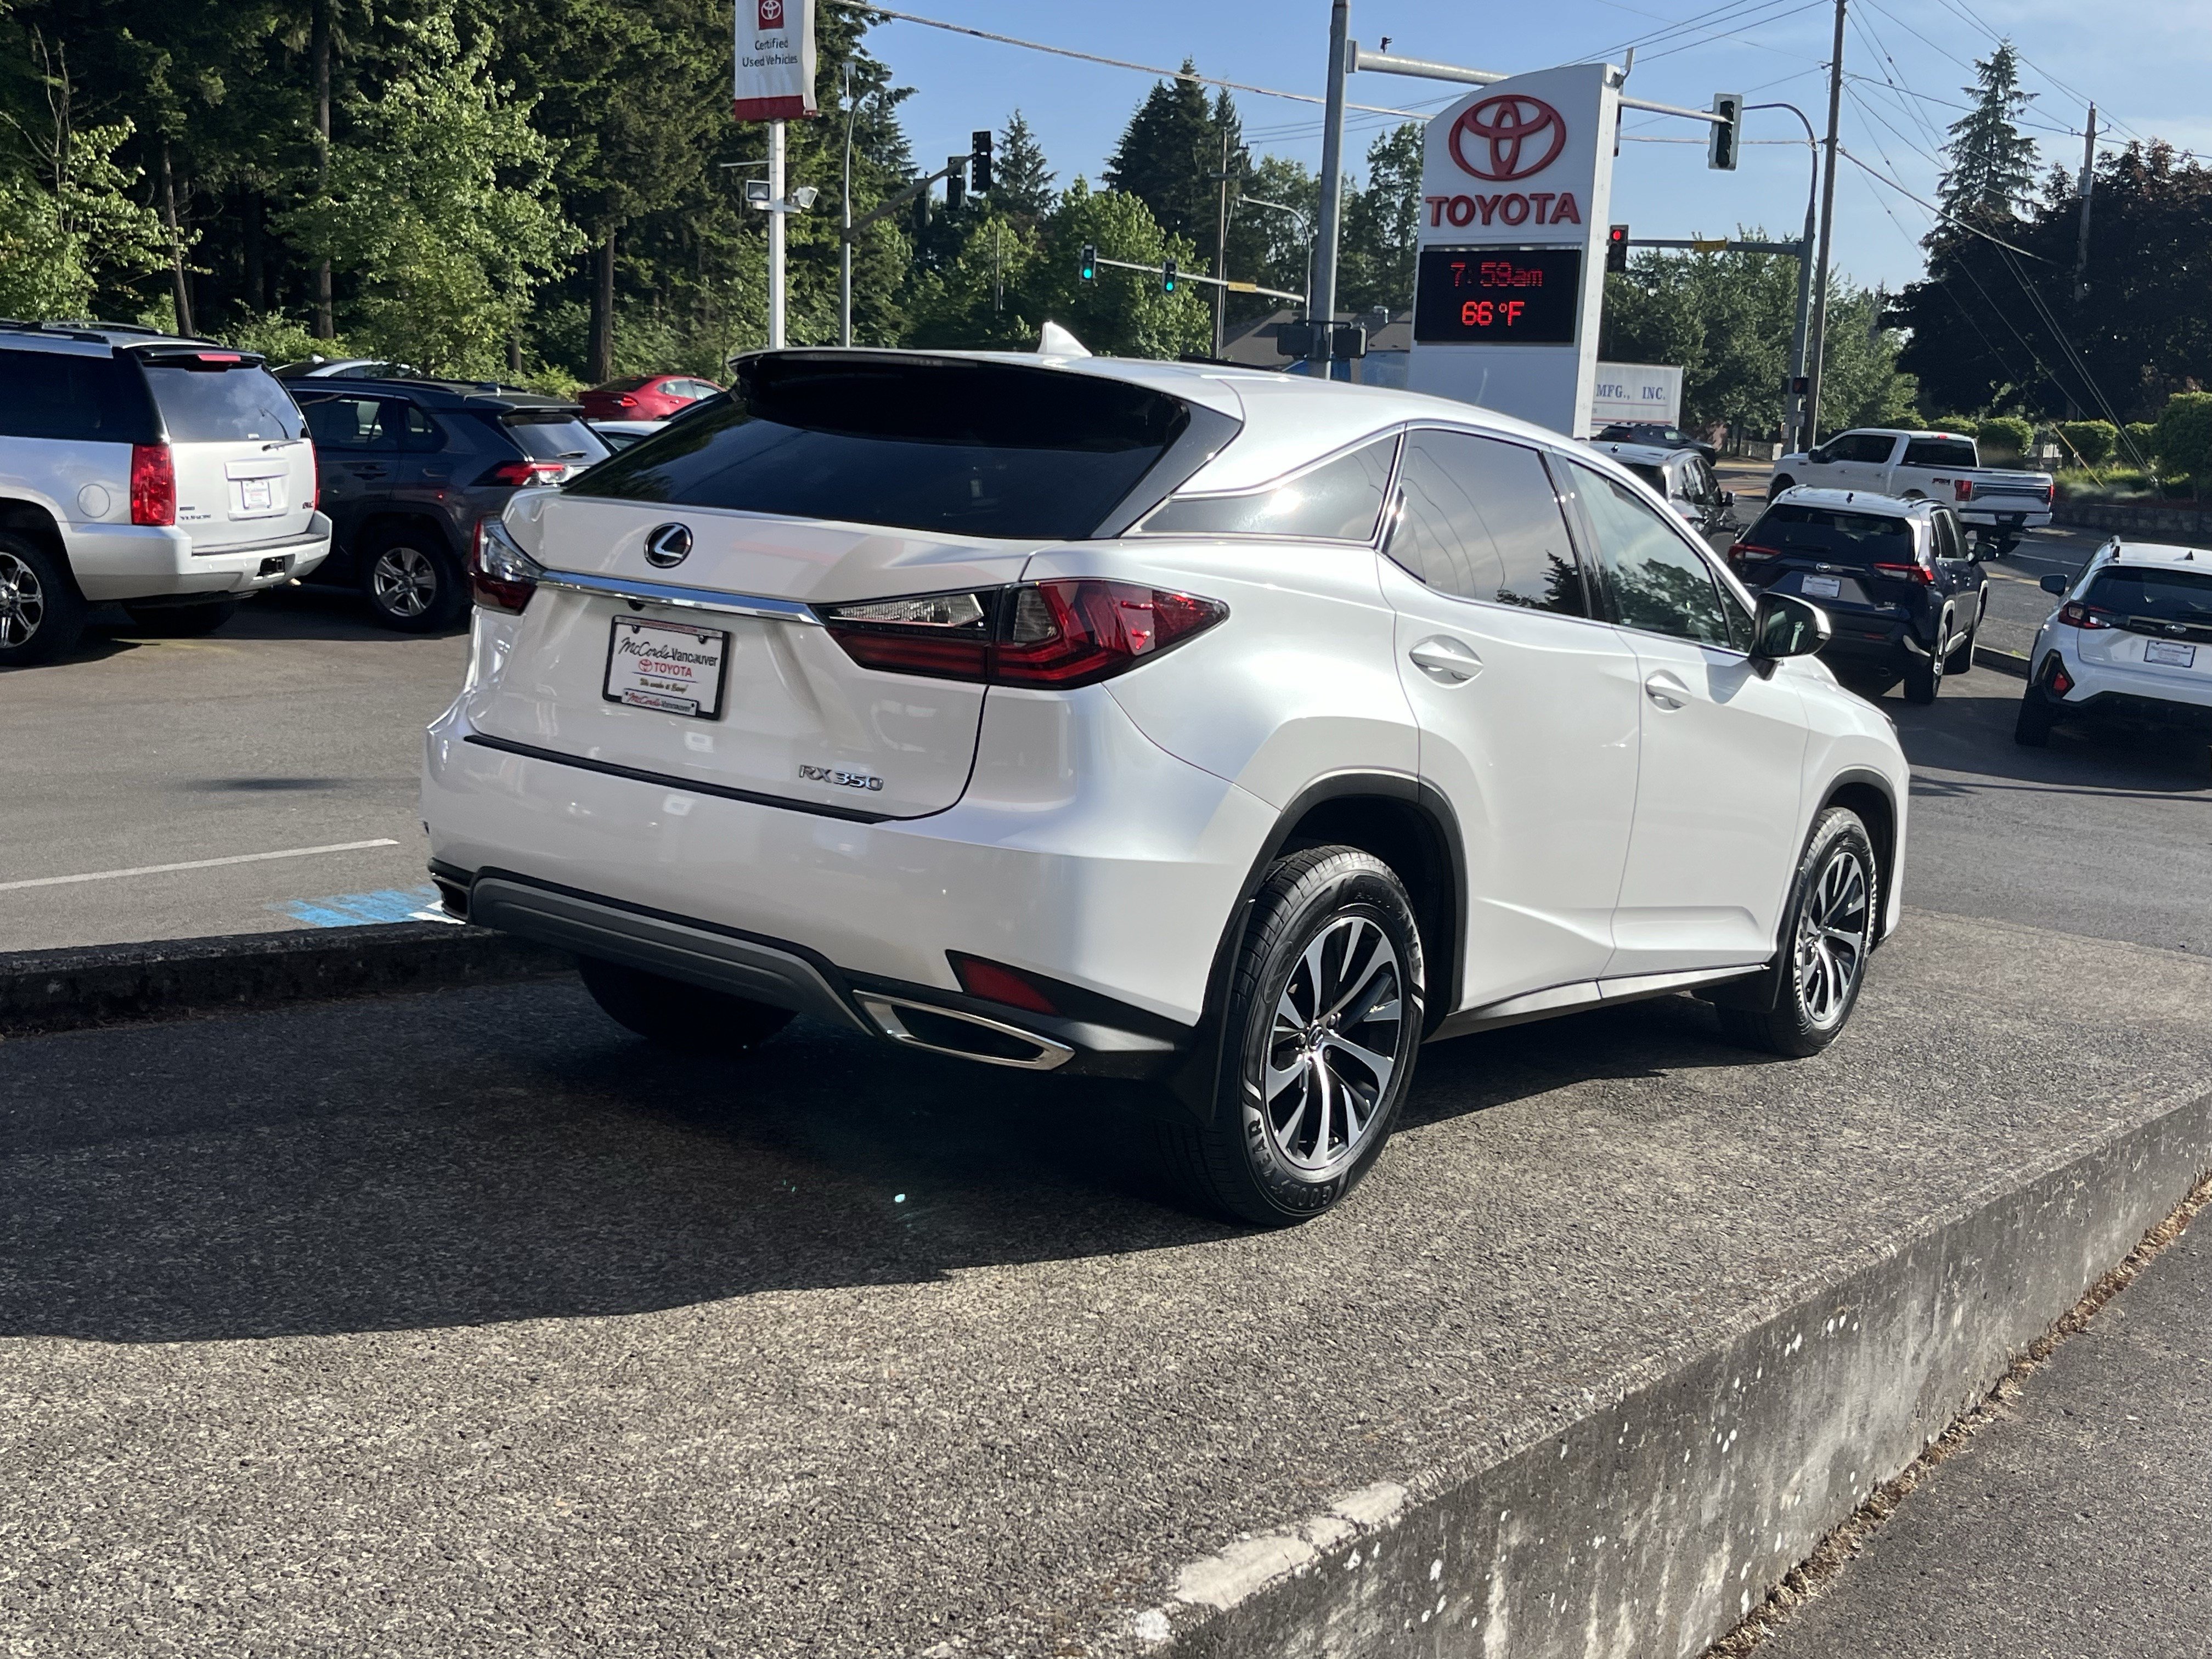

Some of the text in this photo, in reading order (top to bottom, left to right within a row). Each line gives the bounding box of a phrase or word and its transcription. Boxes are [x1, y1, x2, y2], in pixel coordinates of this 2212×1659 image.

[755, 37, 789, 50] Certified
[742, 54, 798, 67] Used Vehicles
[1425, 193, 1582, 227] TOYOTA
[1642, 386, 1666, 400] INC.
[672, 648, 718, 667] Vancouver
[654, 662, 693, 678] TOYOTA
[799, 764, 884, 791] RX 350
